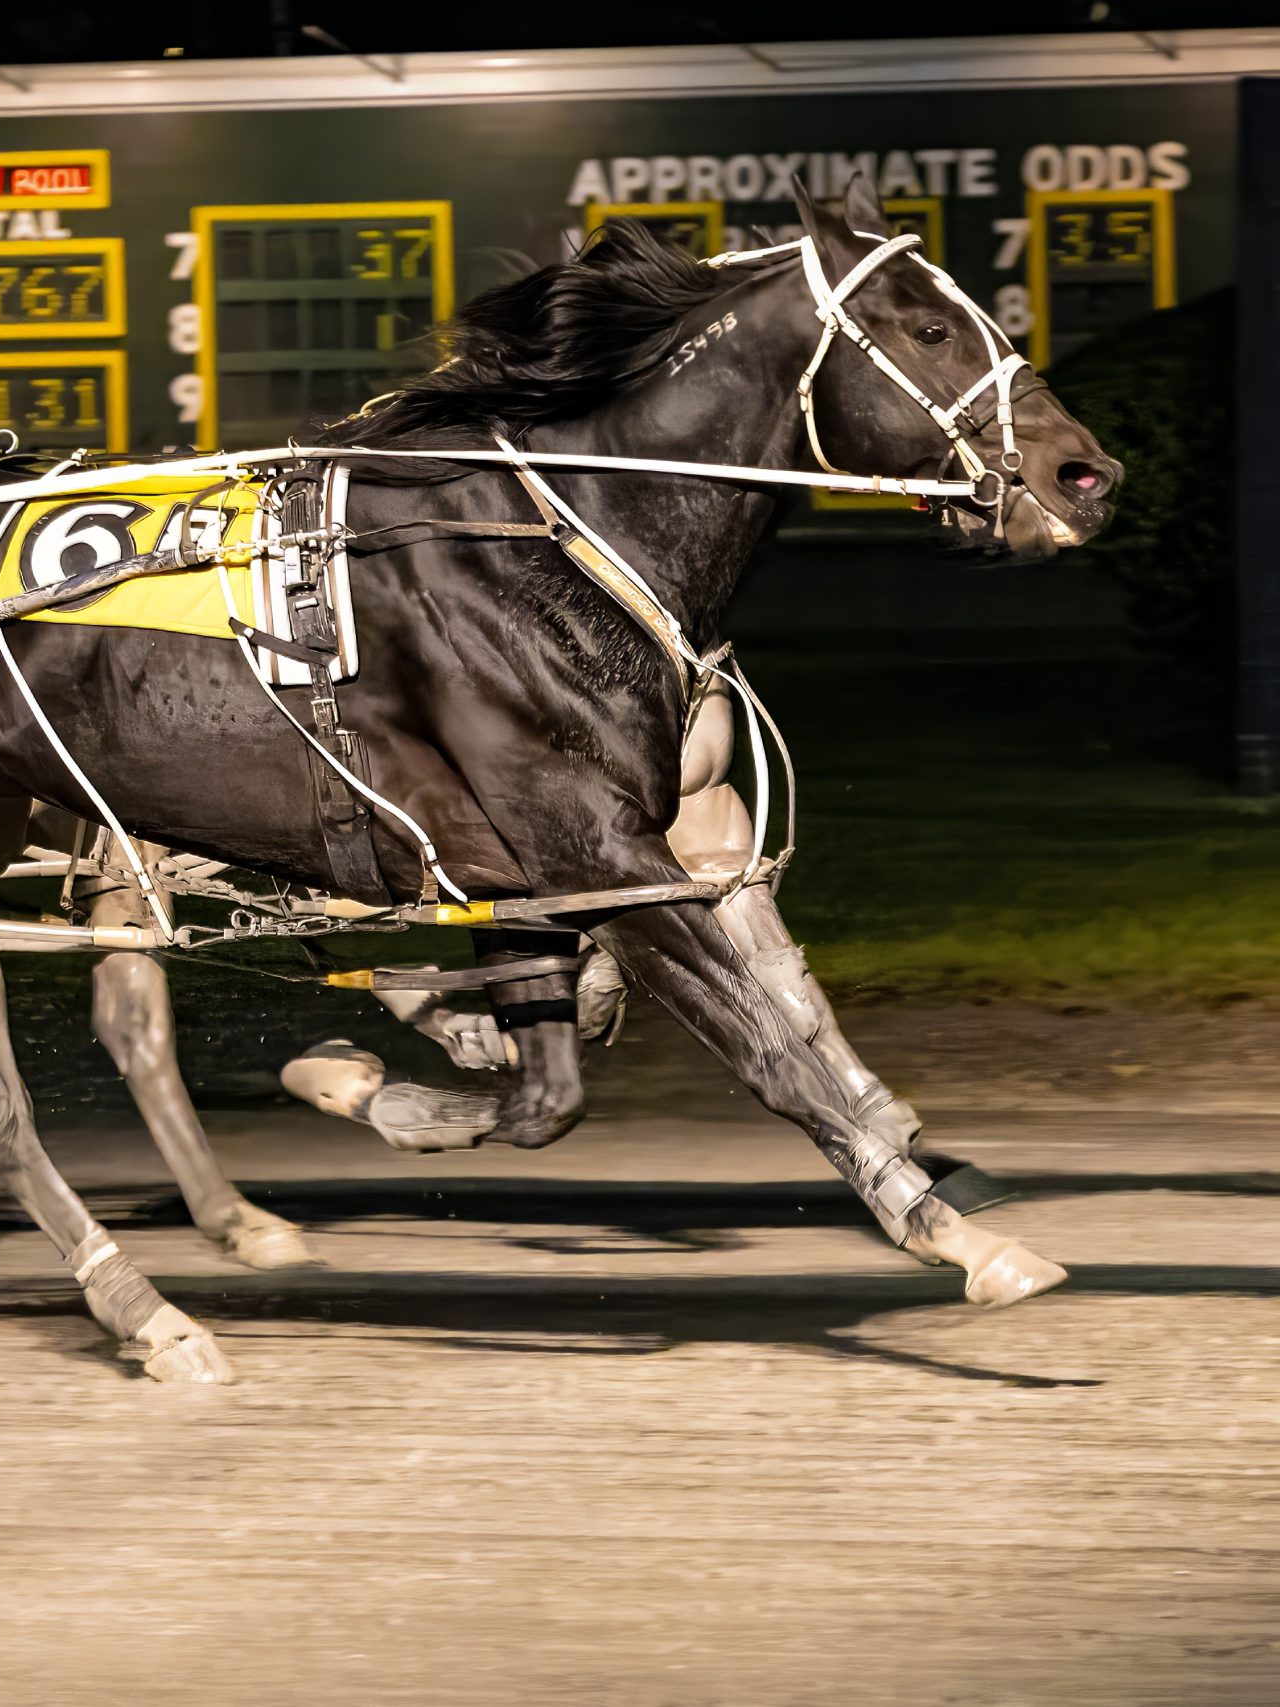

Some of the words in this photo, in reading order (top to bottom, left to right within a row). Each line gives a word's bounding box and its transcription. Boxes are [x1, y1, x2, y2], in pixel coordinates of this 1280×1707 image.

[568, 148, 998, 206] APPROXIMATE
[1024, 142, 1191, 193] ODDS
[164, 232, 200, 280] 7
[352, 228, 432, 280] 37
[992, 219, 1031, 269] 7
[1051, 211, 1152, 264] 35
[167, 304, 202, 354] 8
[993, 284, 1035, 337] 8
[168, 373, 205, 424] 9
[26, 500, 144, 602] 6
